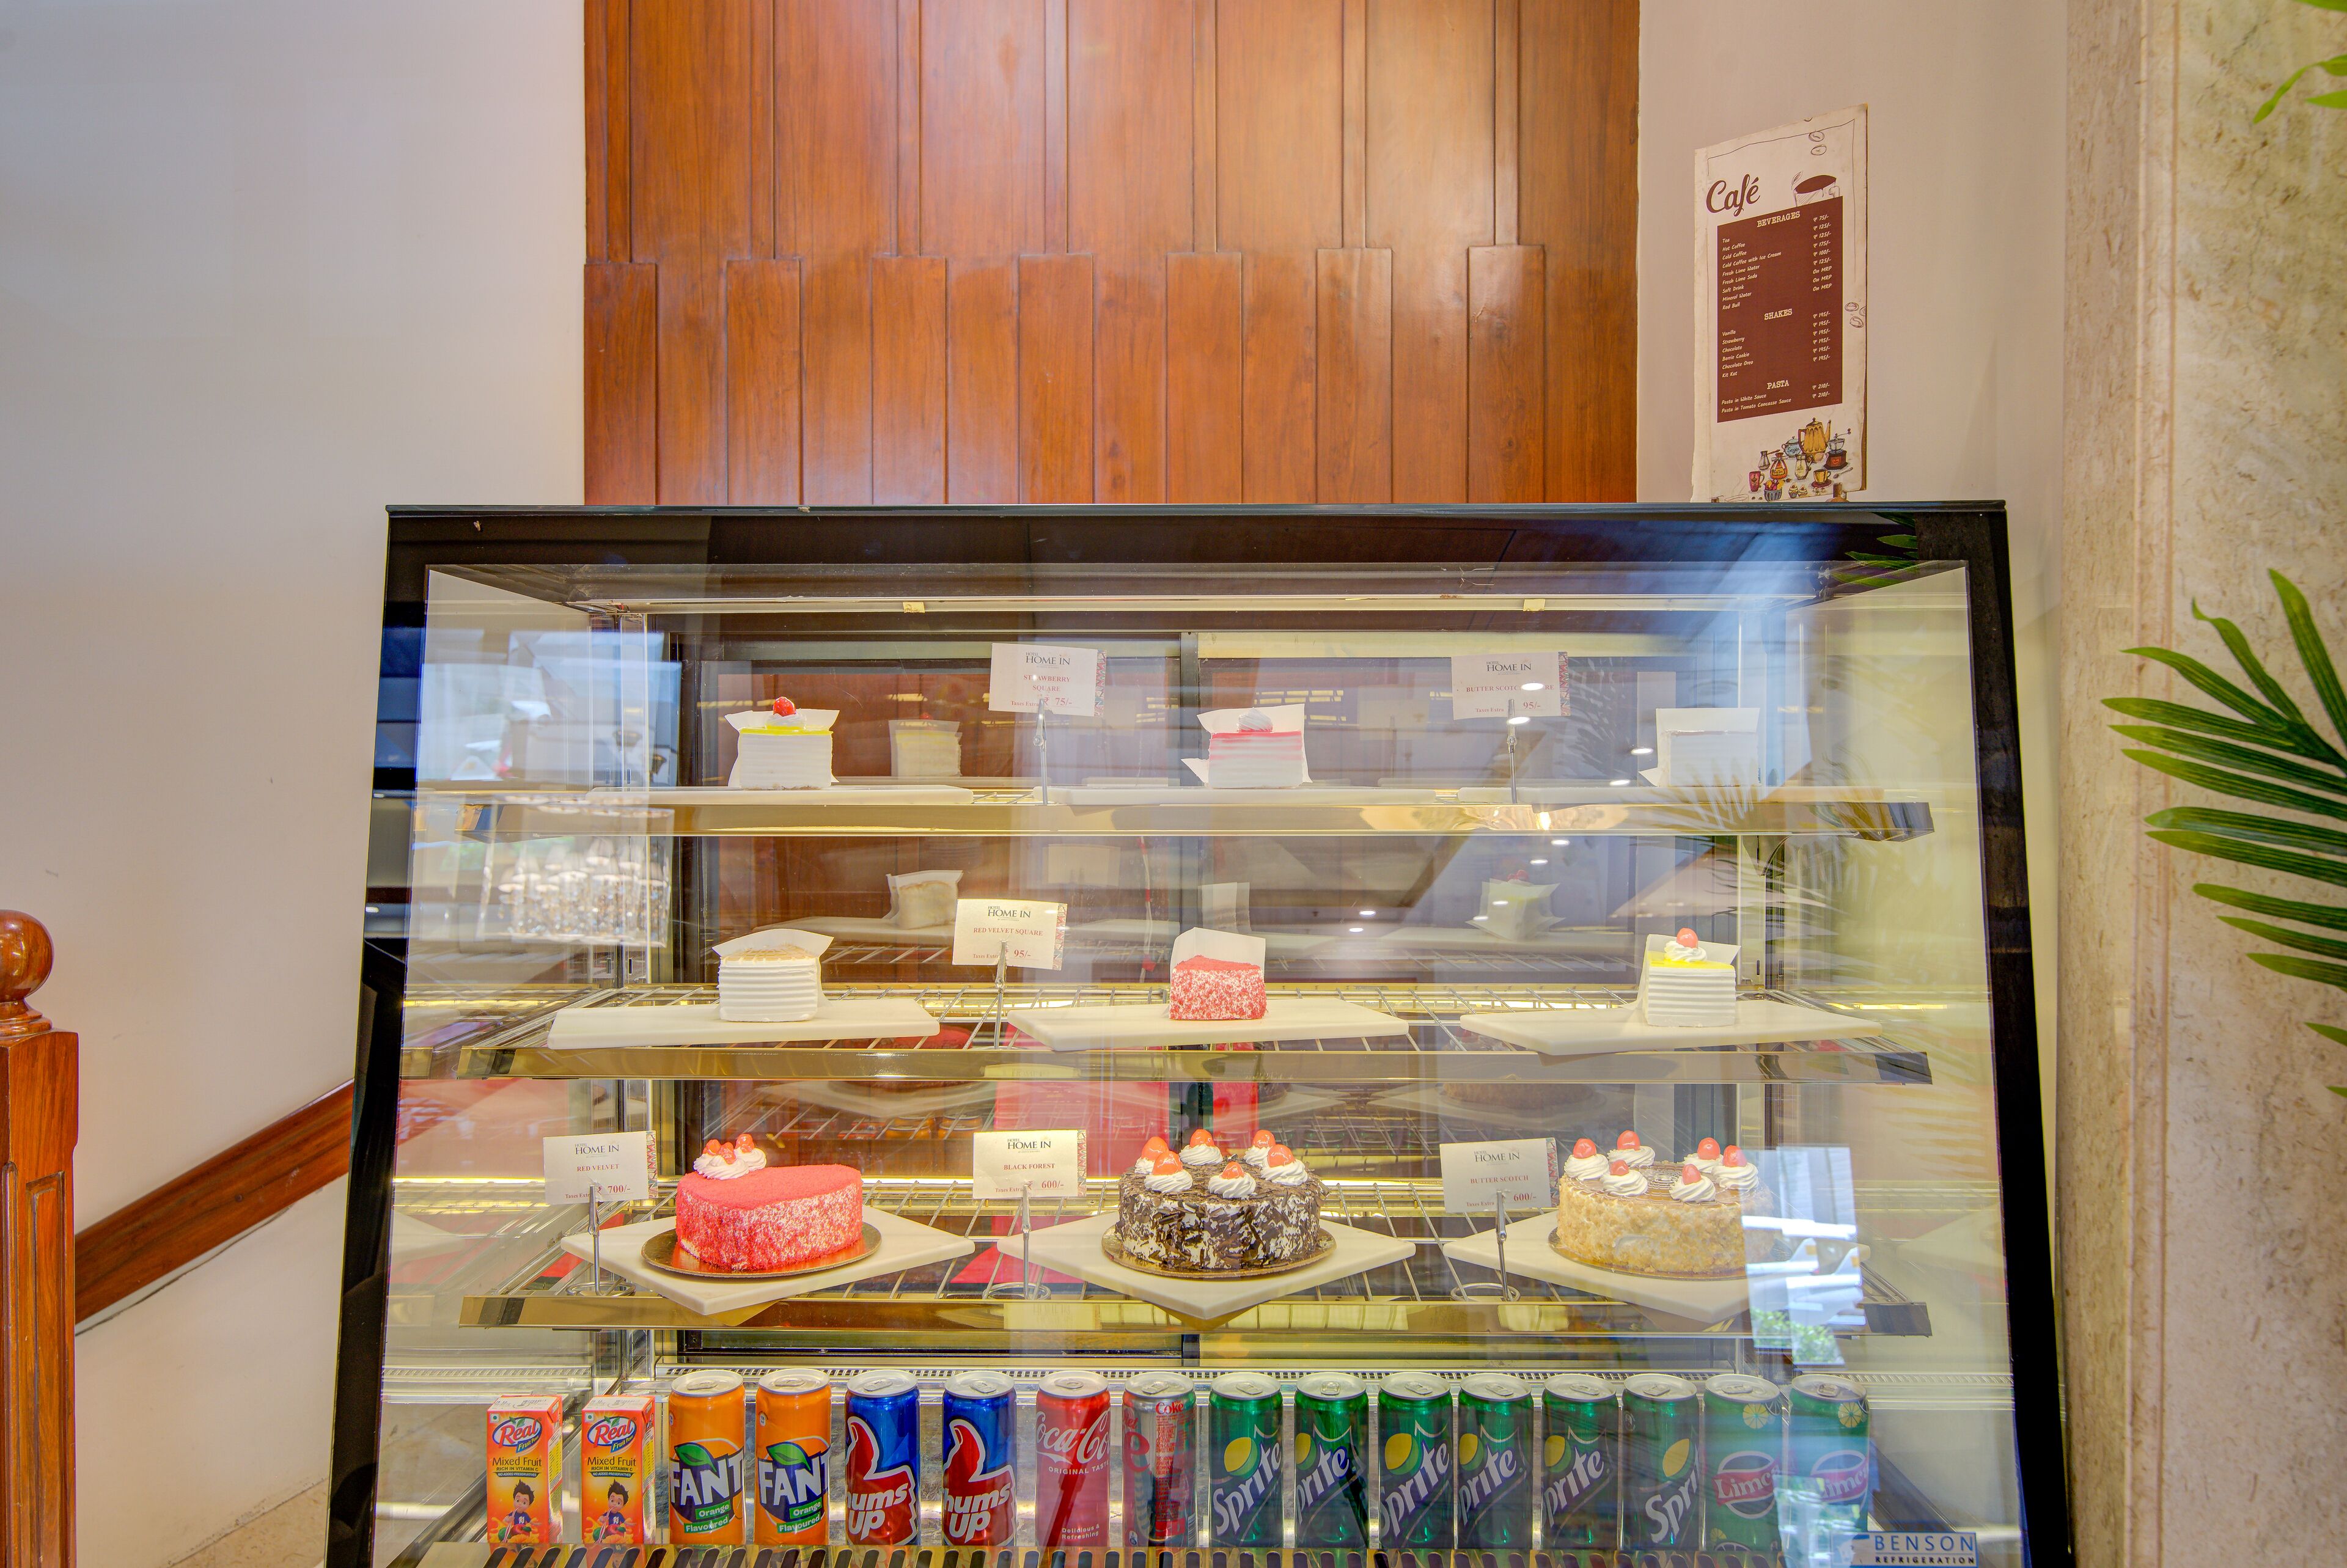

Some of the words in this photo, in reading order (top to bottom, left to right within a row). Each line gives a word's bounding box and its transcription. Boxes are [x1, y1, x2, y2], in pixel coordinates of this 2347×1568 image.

[1706, 174, 1760, 217] Café
[1757, 211, 1801, 227] BEVERAGES
[1764, 309, 1793, 320] SHAKES
[1767, 379, 1790, 389] PASTA
[1026, 655, 1056, 665] HOME
[1059, 656, 1070, 665] IN
[1023, 674, 1071, 683] STAWBERRY
[1055, 697, 1072, 706] 75/-
[988, 909, 1017, 918] HOME
[1014, 949, 1031, 958] 95/-
[575, 1145, 605, 1154] HOME
[1007, 1141, 1037, 1149] HOME
[1475, 1153, 1506, 1162] HOME
[608, 1185, 631, 1194] 700/-
[1041, 1180, 1064, 1189] 600/-
[1513, 1193, 1537, 1201] 600/-
[1155, 1401, 1184, 1415] Coke
[499, 1420, 538, 1448] Real
[593, 1419, 633, 1448] Real
[1037, 1408, 1111, 1464] Coca-Co
[518, 1440, 531, 1451] Fruit
[612, 1441, 626, 1451] Fruit
[492, 1457, 520, 1466] Mixed
[523, 1457, 542, 1467] Fruit
[587, 1457, 615, 1465] Mixed
[618, 1457, 636, 1467] Fruit
[1048, 1466, 1089, 1475] ORIGINAL
[1092, 1460, 1109, 1472] TASTE
[1213, 1442, 1282, 1536] Sprite
[1296, 1443, 1350, 1525] prite
[1459, 1443, 1517, 1526] prite
[1541, 1446, 1604, 1529] prite
[699, 1504, 729, 1517] Orange
[793, 1501, 821, 1517] Orange
[686, 1516, 728, 1533] Flavoured
[779, 1514, 820, 1532] Flavoured
[1062, 1531, 1099, 1540] Refreshing
[1875, 1535, 1973, 1551] BENSON
